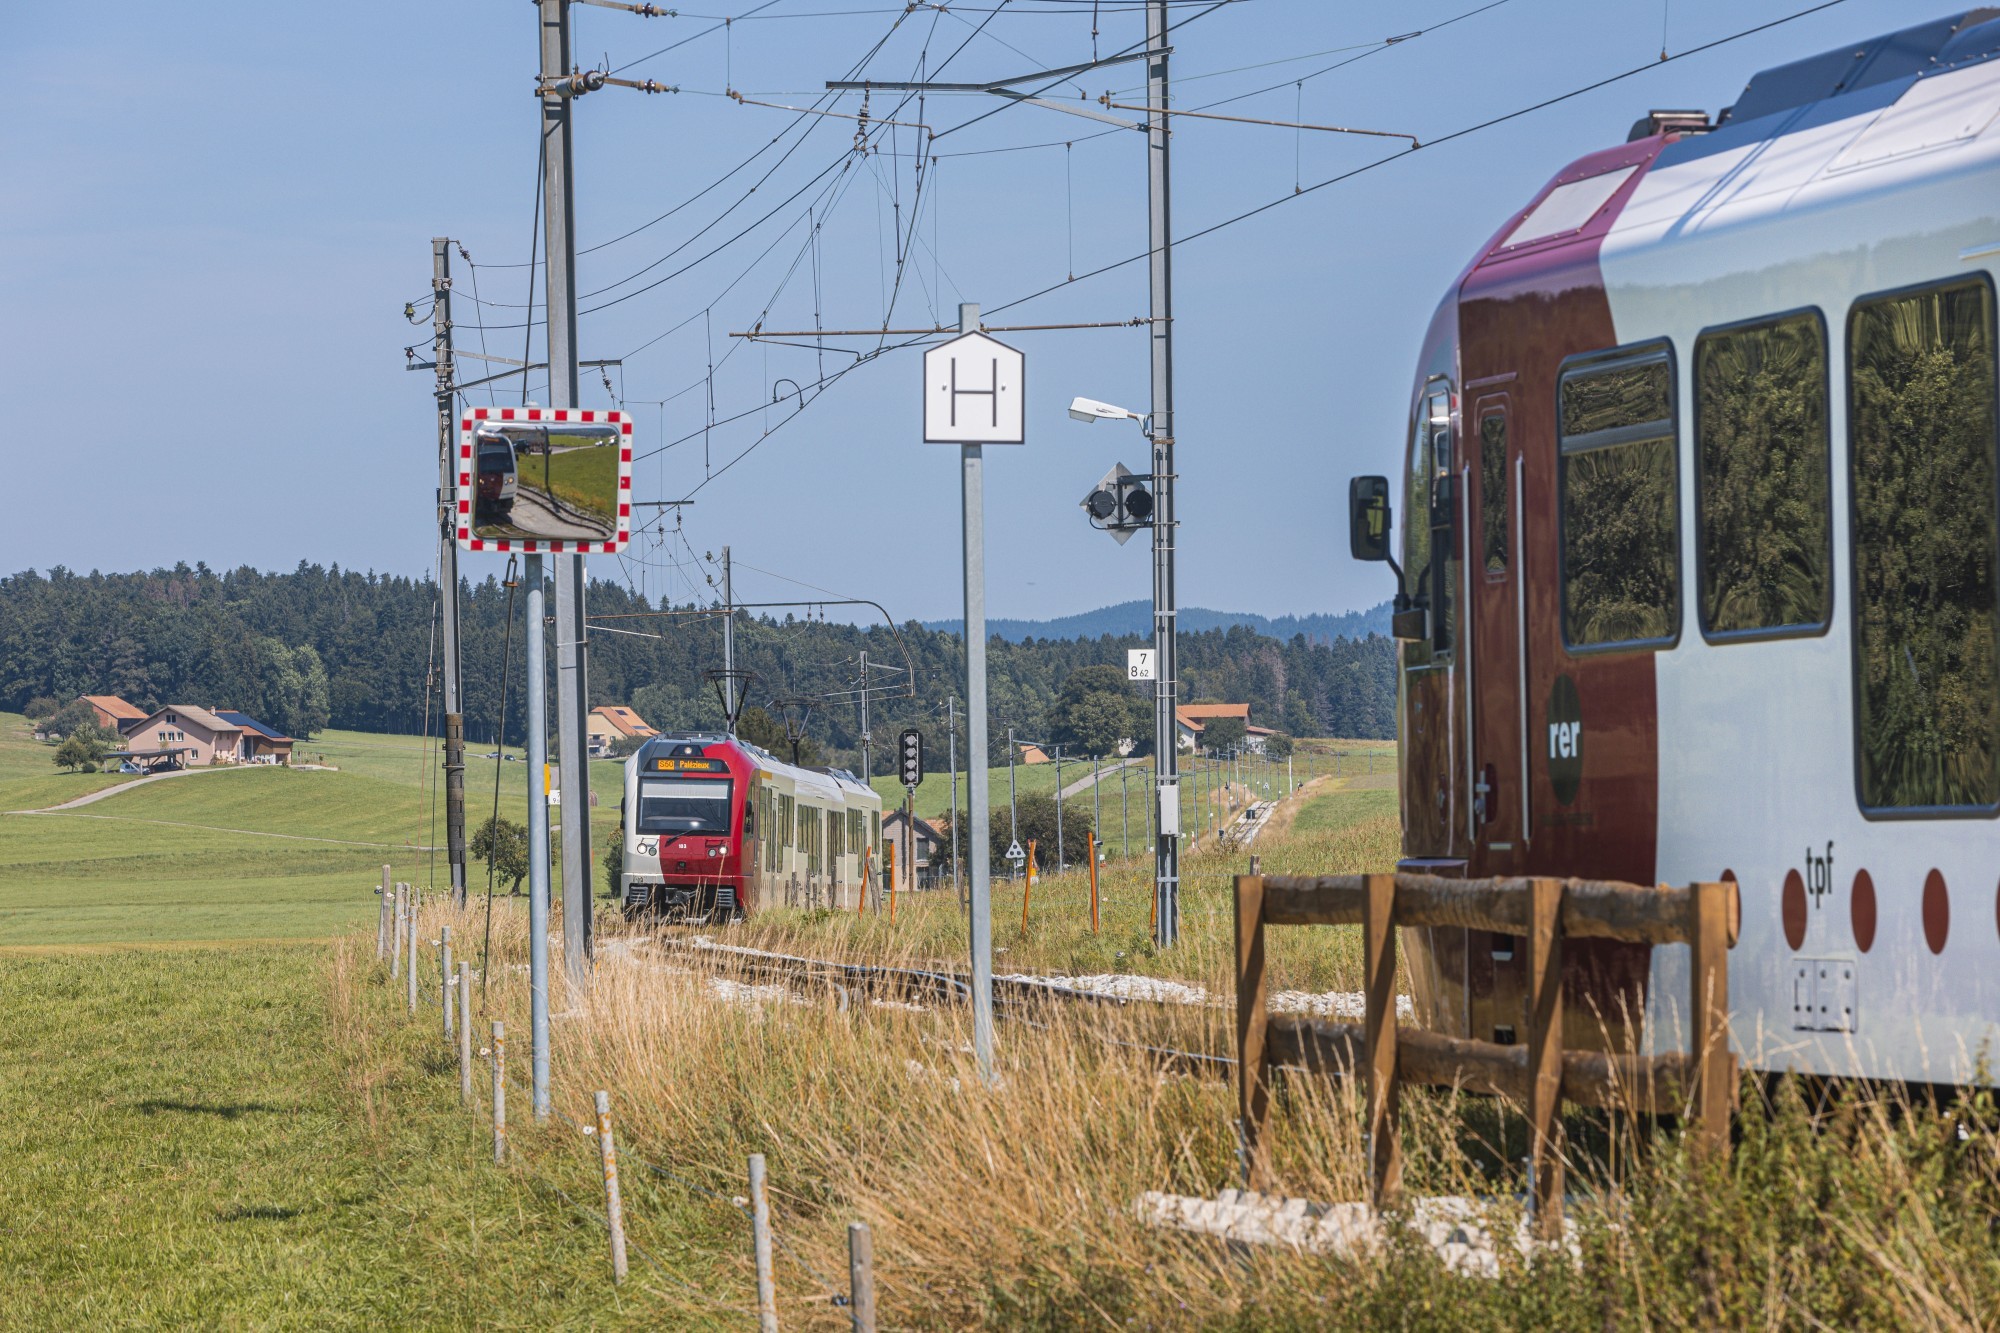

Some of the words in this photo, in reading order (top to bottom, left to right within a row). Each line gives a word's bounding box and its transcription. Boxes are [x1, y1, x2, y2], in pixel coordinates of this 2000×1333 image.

[951, 357, 997, 427] H
[1140, 654, 1146, 664] 7
[1131, 666, 1137, 677] 8
[1549, 721, 1581, 759] rer
[659, 760, 674, 768] S60
[1806, 840, 1834, 909] tpf
